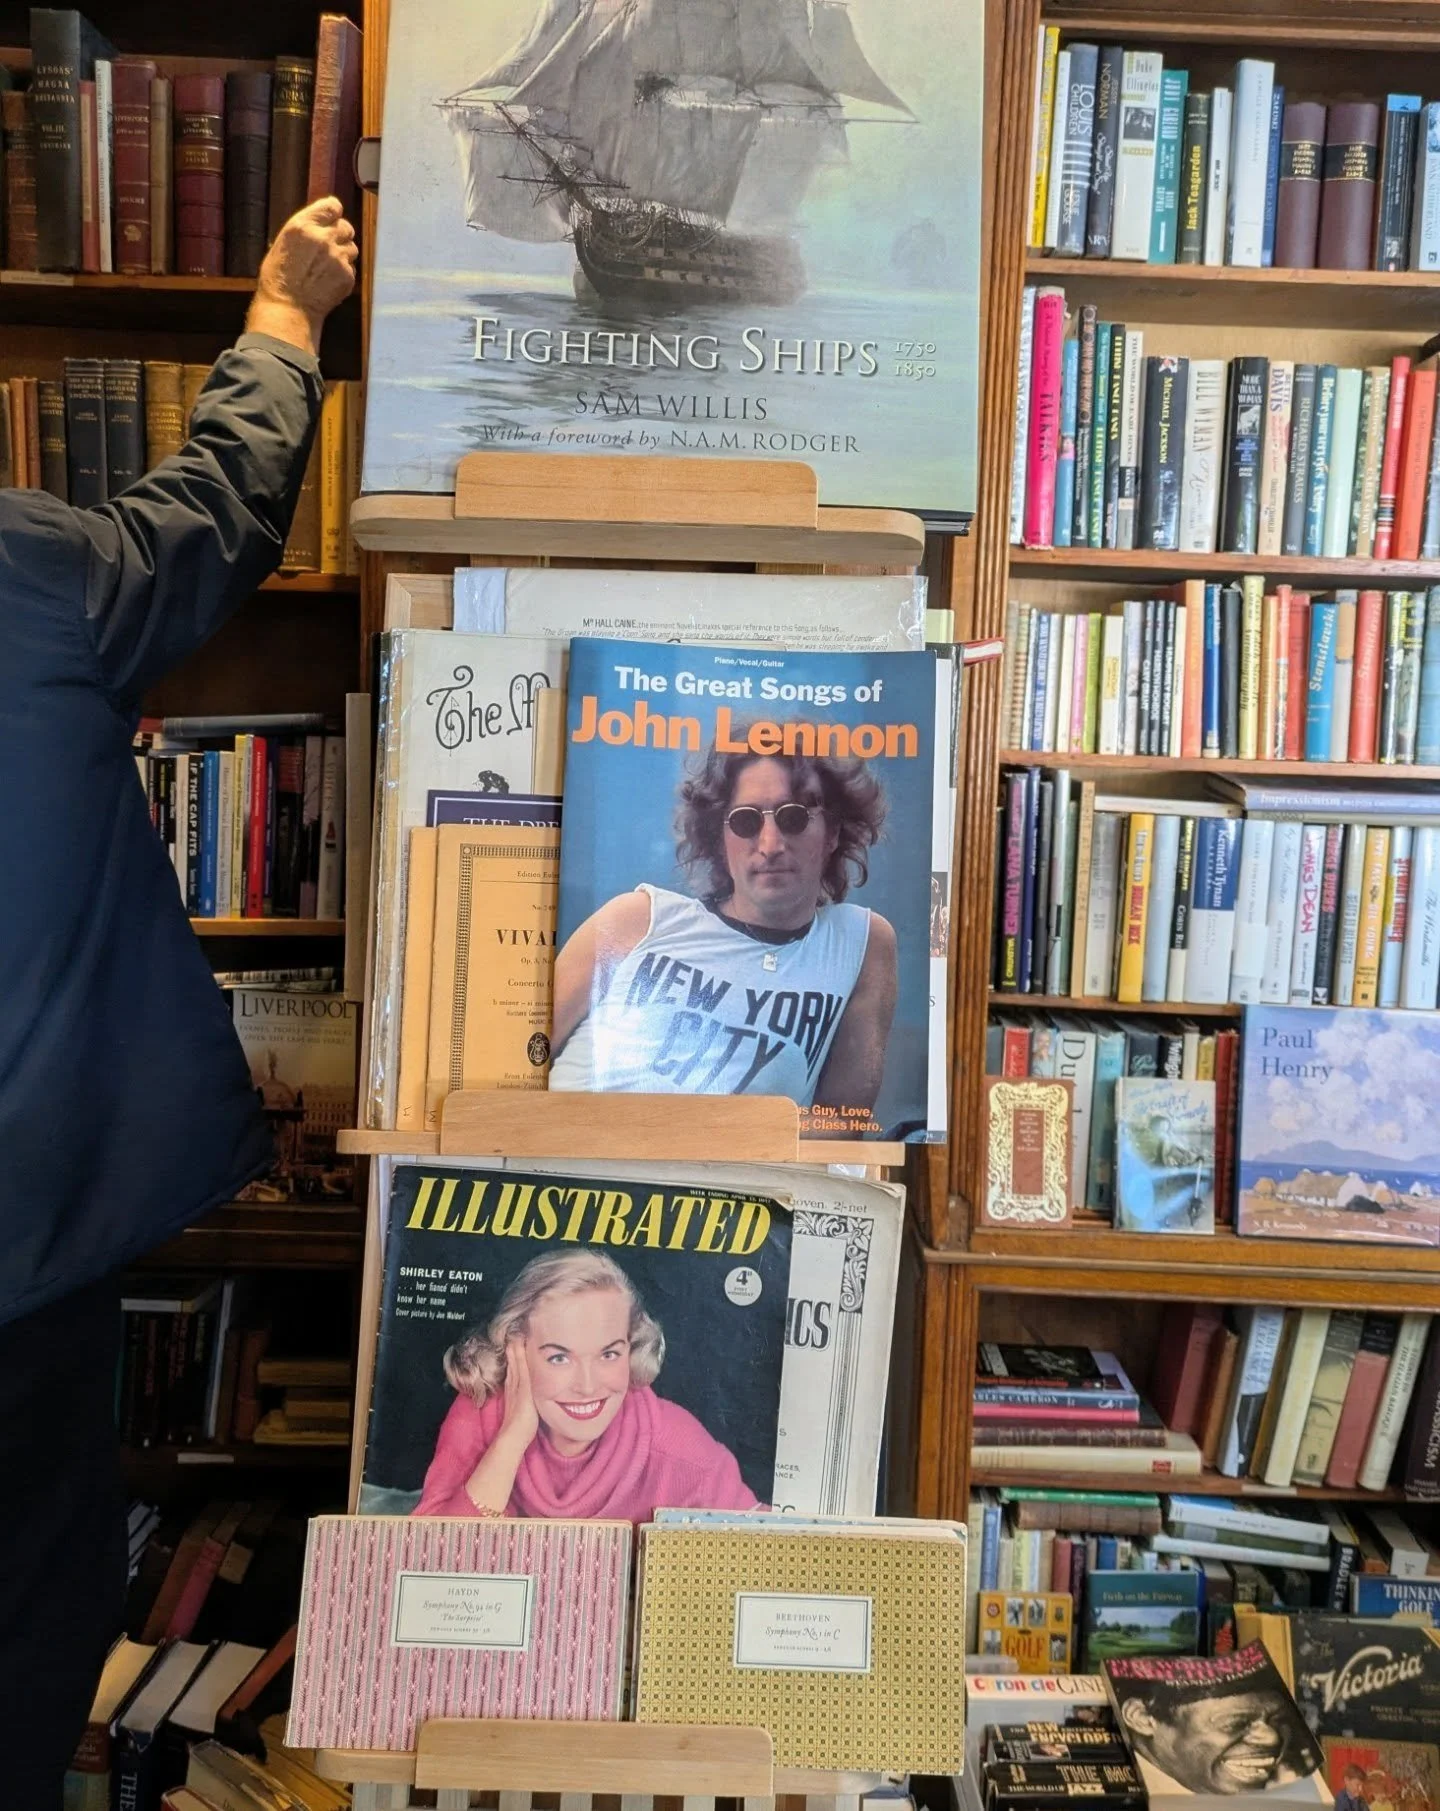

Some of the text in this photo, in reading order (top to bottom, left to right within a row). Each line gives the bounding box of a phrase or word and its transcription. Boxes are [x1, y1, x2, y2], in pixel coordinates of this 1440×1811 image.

[1098, 62, 1112, 120] NORMAN
[1068, 83, 1080, 136] CHILDREN
[1186, 145, 1202, 231] Jack Teagarden
[895, 340, 937, 357] 1750
[894, 362, 937, 379] 1850
[1270, 367, 1285, 412] DAVIS
[1320, 377, 1334, 413] Before
[574, 390, 769, 421] SAM WILLIS
[1193, 371, 1219, 453] BILL WYMAN
[1040, 392, 1053, 462] TALKIES
[1158, 376, 1174, 465] MICHAEL JACKSON
[1316, 412, 1330, 434] your
[482, 424, 526, 444] With
[531, 431, 544, 445] a
[546, 426, 634, 449] foreword
[638, 430, 661, 451] by
[752, 432, 861, 454] RODGER
[1294, 397, 1310, 504] RICHARD STRAUSS
[595, 618, 613, 628] HALL
[714, 656, 785, 668] Piano/Vocal/Guitar
[1309, 608, 1336, 692] Stanislavski
[614, 666, 883, 706] The Great Songs of
[1141, 682, 1149, 711] GRANT
[1163, 646, 1173, 725] HUMPHREY BOGART
[426, 665, 502, 751] The
[1151, 685, 1159, 721] MONROE
[571, 696, 919, 758] John Lennon
[189, 762, 198, 857] IF THE CAP FITS
[1260, 793, 1341, 808] Impressionism
[1007, 836, 1021, 880] LANA
[1214, 829, 1228, 875] Kenneth
[1323, 826, 1339, 872] GEORGE
[516, 870, 541, 879] Edition
[1301, 833, 1323, 934] JAMES DEAN
[1130, 884, 1144, 921] BRIAN
[1212, 874, 1228, 908] Tynan
[1321, 873, 1338, 913] BURNS
[1004, 881, 1020, 935] TURNER
[1175, 904, 1186, 932] CORIN
[1127, 924, 1142, 945] RIX
[1365, 925, 1377, 959] YOUNG
[520, 957, 531, 966] Op.
[507, 978, 545, 988] Concerto
[240, 992, 353, 1019] LIVERPOOL
[623, 952, 844, 1087] NEW YORK
[1260, 1026, 1315, 1049] Paul
[650, 1010, 787, 1095] CITY
[1261, 1055, 1334, 1084] Henry
[812, 1104, 874, 1118] Guy, Love,
[813, 1119, 883, 1132] Class Hero.
[405, 1176, 772, 1256] ILLUSTRATED
[400, 1266, 483, 1281] SHIRLEY EATON
[416, 1281, 426, 1291] her
[450, 1283, 468, 1294] didn't
[395, 1307, 435, 1320] Cover picture by
[396, 1293, 446, 1306] know her name
[1008, 1393, 1059, 1405] CAMERON
[1335, 1547, 1353, 1598] BRADLEY
[447, 1588, 480, 1596] HAYDN
[1383, 1583, 1440, 1601] THINKIN
[422, 1600, 459, 1611] Symphony
[494, 1602, 502, 1614] G
[455, 1614, 483, 1624] Surprise'
[776, 1612, 831, 1623] BEETHOVEN
[1398, 1601, 1434, 1614] GOLF
[765, 1626, 801, 1639] Symphony
[833, 1628, 841, 1640] C
[1005, 1636, 1046, 1659] GOLF
[1026, 1721, 1059, 1732] NEW
[1056, 1765, 1100, 1783] THE
[1026, 1785, 1054, 1793] WORLD
[1067, 1783, 1105, 1796] JAZZ
